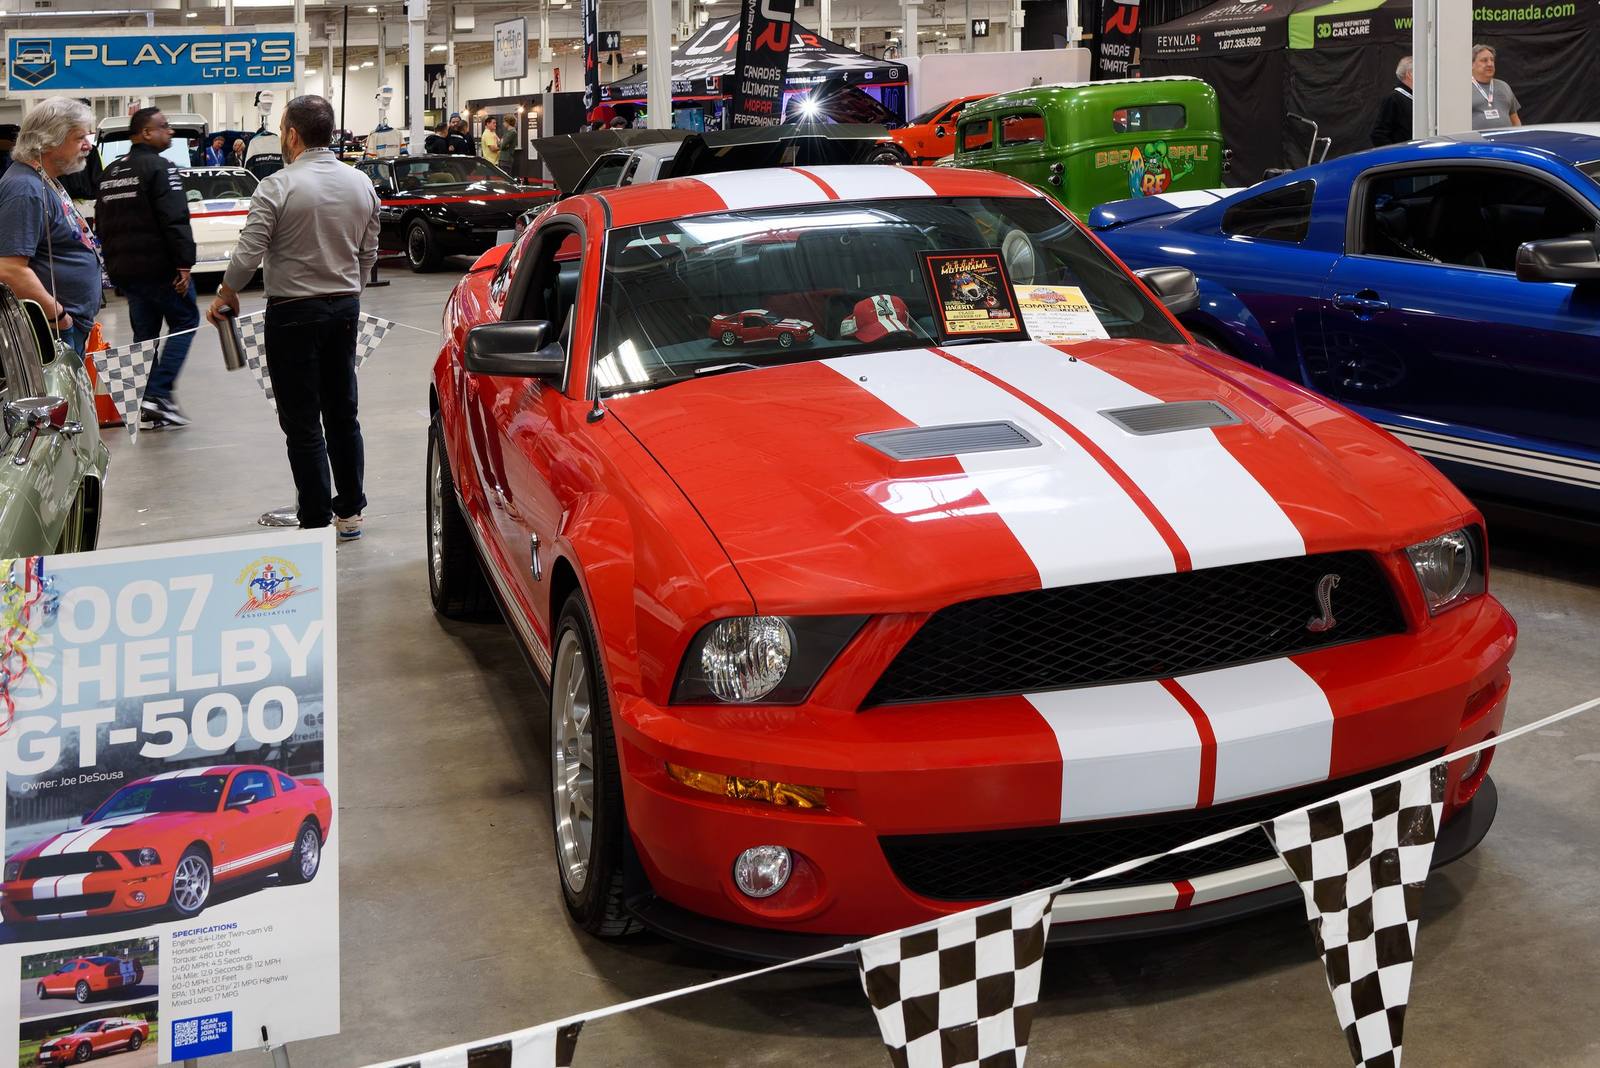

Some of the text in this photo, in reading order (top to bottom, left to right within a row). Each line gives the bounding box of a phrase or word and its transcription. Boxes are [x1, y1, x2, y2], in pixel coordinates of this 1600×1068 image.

[1317, 23, 1332, 38] 3D
[1344, 19, 1370, 27] DEFINITION
[1333, 26, 1370, 37] CAR CARE
[1157, 34, 1196, 46] FEYNLAB
[64, 38, 291, 67] PLAYER'S
[202, 65, 291, 78] LTD. CUP
[744, 65, 782, 80] CANADA'S
[742, 82, 780, 97] ULTIMATE
[744, 100, 773, 113] MOPAR
[734, 113, 780, 127] PERFORMANCE
[241, 609, 297, 619] ASSOCIATION
[12, 620, 323, 711] SHELBY
[6, 685, 298, 775] GT-500
[21, 770, 124, 792] Owner: Joe DeSousa
[172, 922, 238, 939] SPECIFICATIONS
[217, 940, 231, 949] 500
[215, 950, 224, 958] Lb
[225, 947, 241, 956] Feet
[172, 963, 190, 973] 0-60
[223, 954, 253, 965] Seconds
[214, 964, 245, 975] Seconds
[264, 958, 281, 967] MPH
[172, 981, 190, 991] 60-0
[222, 973, 237, 982] Feet
[197, 985, 215, 995] MPG
[241, 978, 259, 987] MPG
[260, 974, 288, 985] Highway
[172, 998, 193, 1008] Mixed
[222, 990, 239, 999] MPG
[201, 1017, 219, 1025] SCAN
[201, 1023, 217, 1031] HERE
